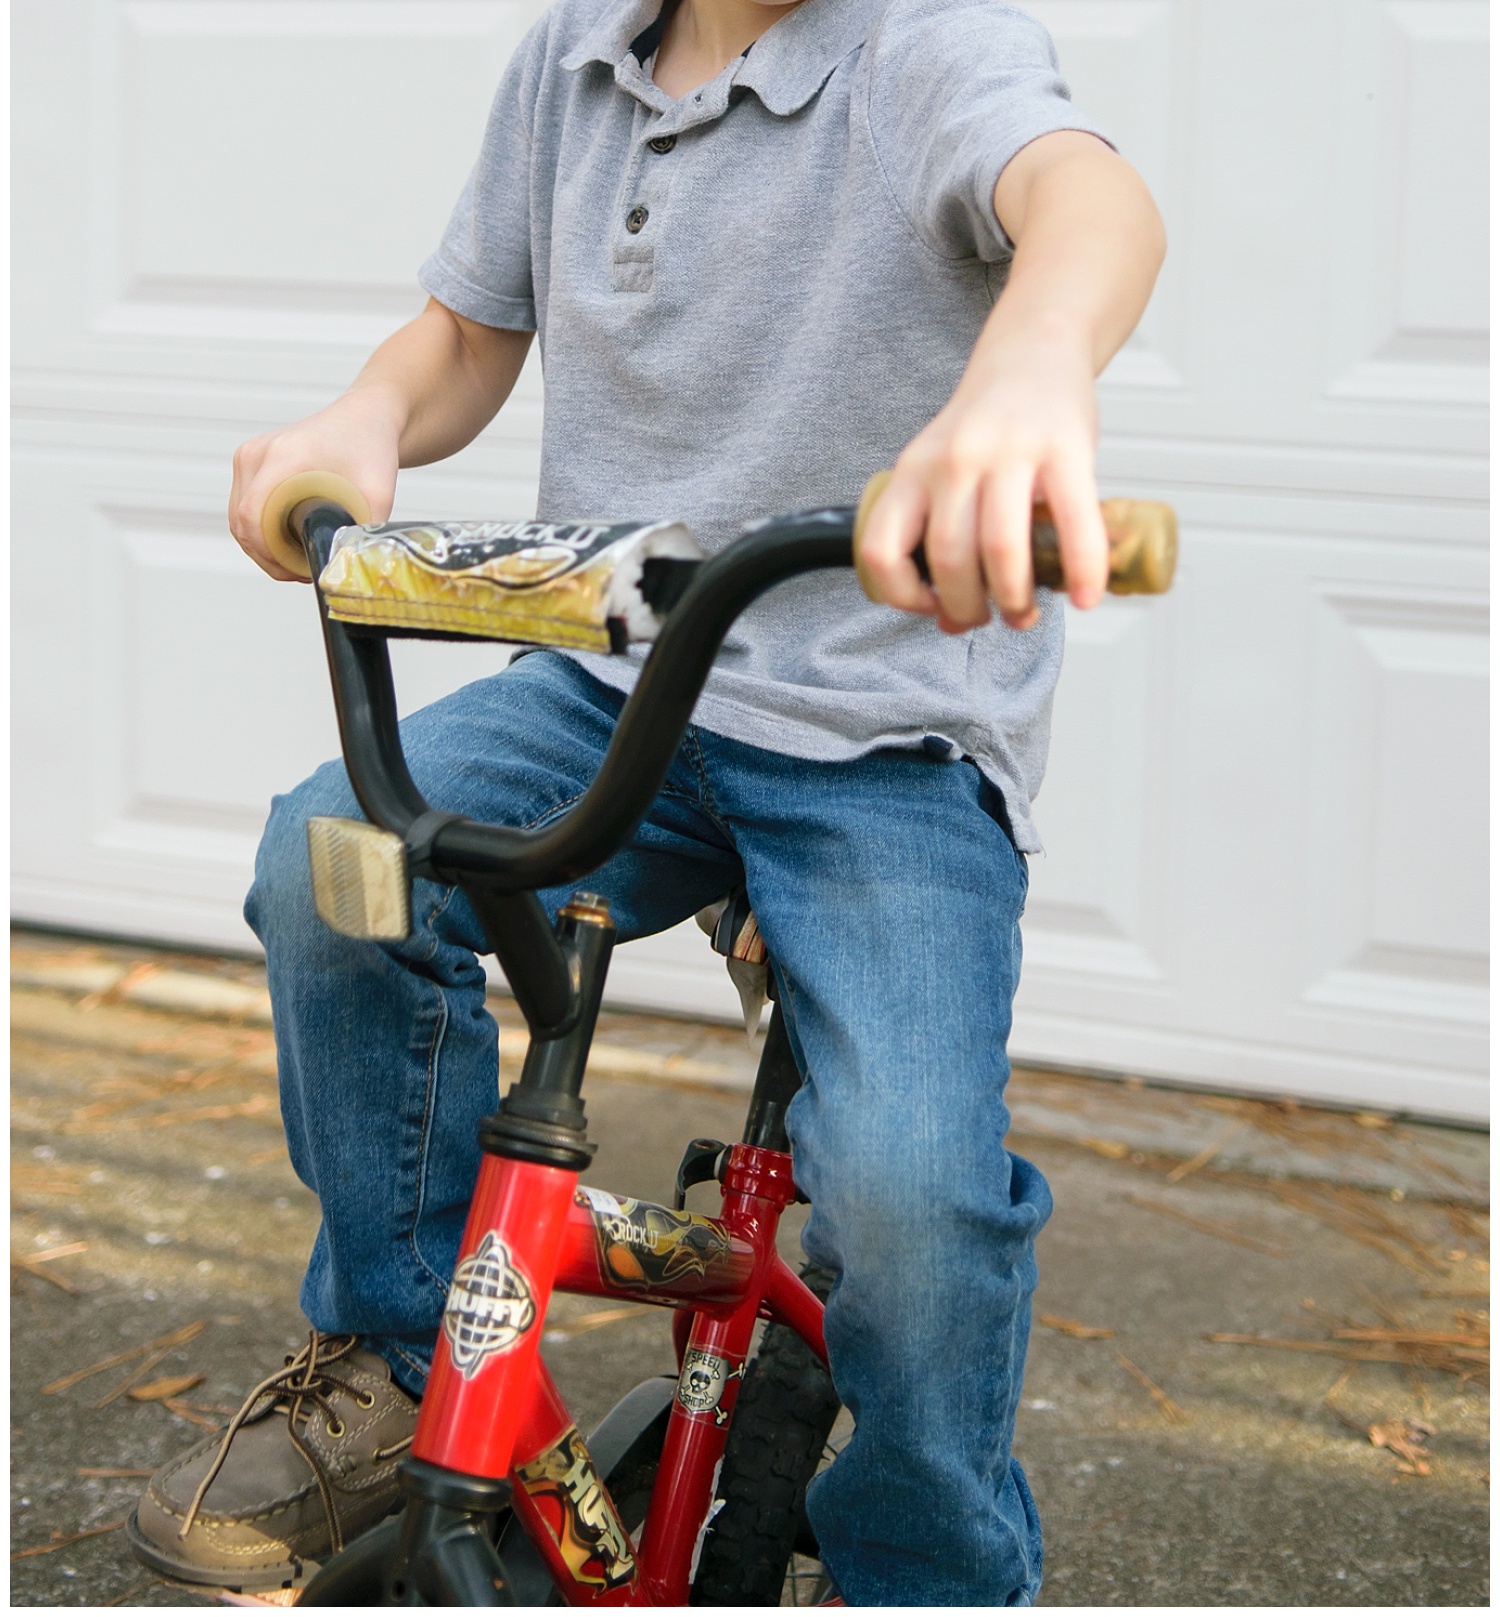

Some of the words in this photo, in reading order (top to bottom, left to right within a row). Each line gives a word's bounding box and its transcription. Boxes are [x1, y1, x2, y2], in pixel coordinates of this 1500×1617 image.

[618, 1220, 647, 1245] ROCK
[445, 1282, 530, 1328] HUFFY
[691, 1352, 721, 1369] SPEED
[684, 1394, 705, 1408] SHOP
